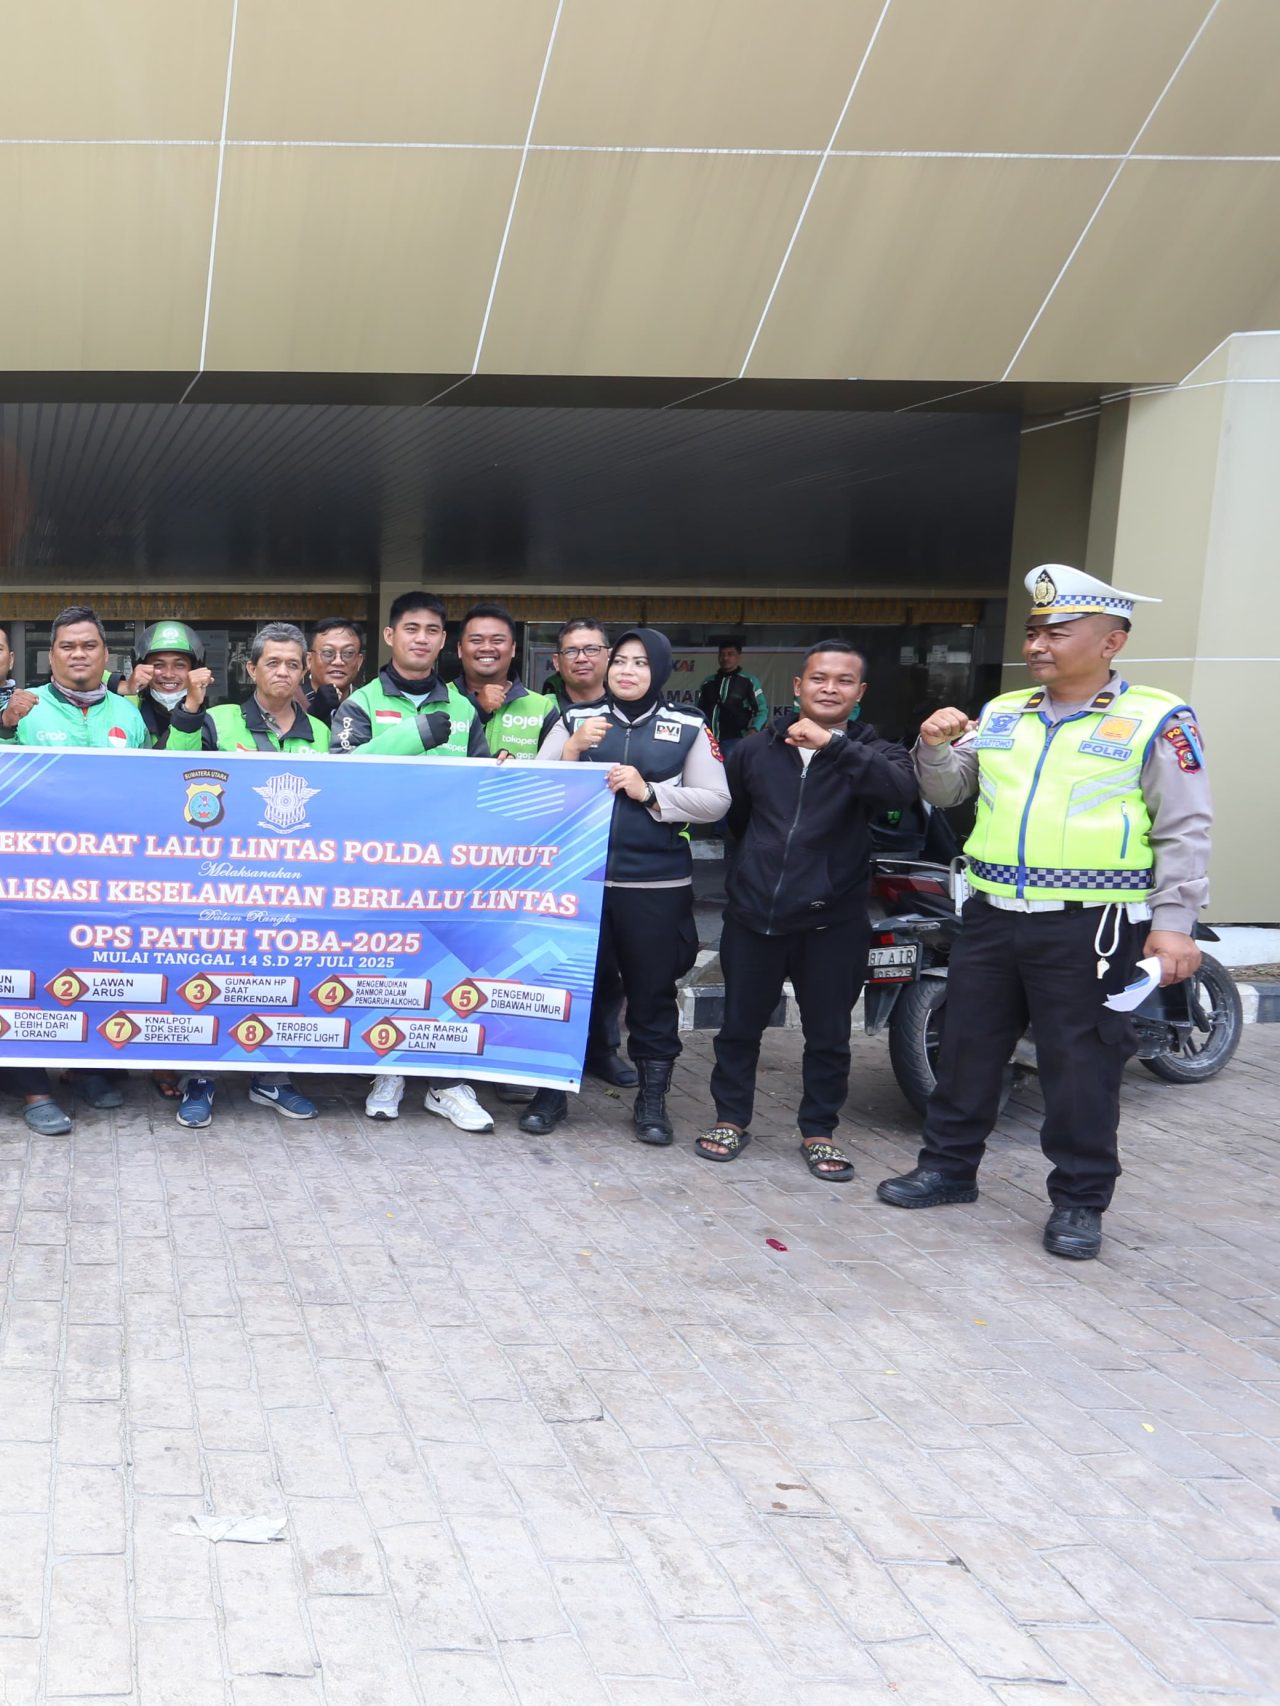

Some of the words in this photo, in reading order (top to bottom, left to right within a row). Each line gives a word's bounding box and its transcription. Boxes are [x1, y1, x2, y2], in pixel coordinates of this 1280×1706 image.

[1082, 743, 1130, 760] POLRI
[184, 770, 211, 780] SUMATERA
[211, 770, 227, 781] UTARA
[144, 836, 223, 858] LALU
[230, 838, 336, 862] LINTAS
[344, 841, 443, 865] POLDA
[451, 845, 559, 867] SUMUT
[198, 861, 303, 879] Melaksanakan
[106, 880, 325, 907] KESELAMATAN
[332, 888, 466, 911] BERLALU
[471, 890, 578, 916] LINTAS
[198, 909, 242, 922] Dalam
[245, 910, 297, 927] Rangka
[70, 925, 132, 948] OPS
[140, 927, 247, 950] PATUH
[254, 929, 421, 953] TOBA-2025
[92, 951, 149, 964] MULAI
[156, 952, 234, 966] TANGGAL
[240, 954, 257, 967] 14
[262, 956, 290, 968] S.D
[294, 956, 312, 967] 27
[316, 956, 353, 968] JULI
[359, 957, 395, 968] 2025
[93, 977, 134, 988] LAWAN
[225, 978, 271, 987] GUNAKAN
[274, 978, 287, 987] HP
[357, 980, 407, 988] MENGEMUDIKAN
[61, 980, 73, 997] 2
[92, 987, 124, 997] ARUS
[193, 983, 205, 1000] 3
[224, 986, 248, 994] SAAT
[324, 985, 338, 1002] 4
[356, 988, 382, 996] RANMOR
[384, 989, 407, 997] DALAM
[224, 994, 288, 1004] BERKENDARA
[355, 996, 390, 1005] PENGARUH
[391, 997, 421, 1006] ALKOHOL
[459, 990, 472, 1007] 5
[492, 989, 545, 1002] PENGEMUDI
[491, 1000, 532, 1012] DIBAWAH
[534, 1003, 561, 1015] UMUR
[14, 1011, 77, 1021] BONCENGAN
[145, 1016, 192, 1025] KNALPOT
[14, 1020, 42, 1029] LEBIH
[45, 1021, 69, 1030] DARI
[113, 1021, 126, 1038] 7
[145, 1024, 164, 1033] TDK
[167, 1025, 204, 1034] SESUAI
[277, 1022, 319, 1032] TEROBOS
[409, 1023, 430, 1032] GAR
[433, 1024, 468, 1034] MARKA
[22, 1029, 57, 1038] ORANG
[144, 1033, 190, 1042] SPEKTEK
[245, 1025, 257, 1042] 8
[276, 1032, 312, 1042] TRAFFIC
[314, 1033, 340, 1043] LIGHT
[377, 1028, 390, 1045] 9
[409, 1032, 429, 1041] DAN
[433, 1033, 468, 1043] RAMBU
[408, 1041, 436, 1049] LALIN
